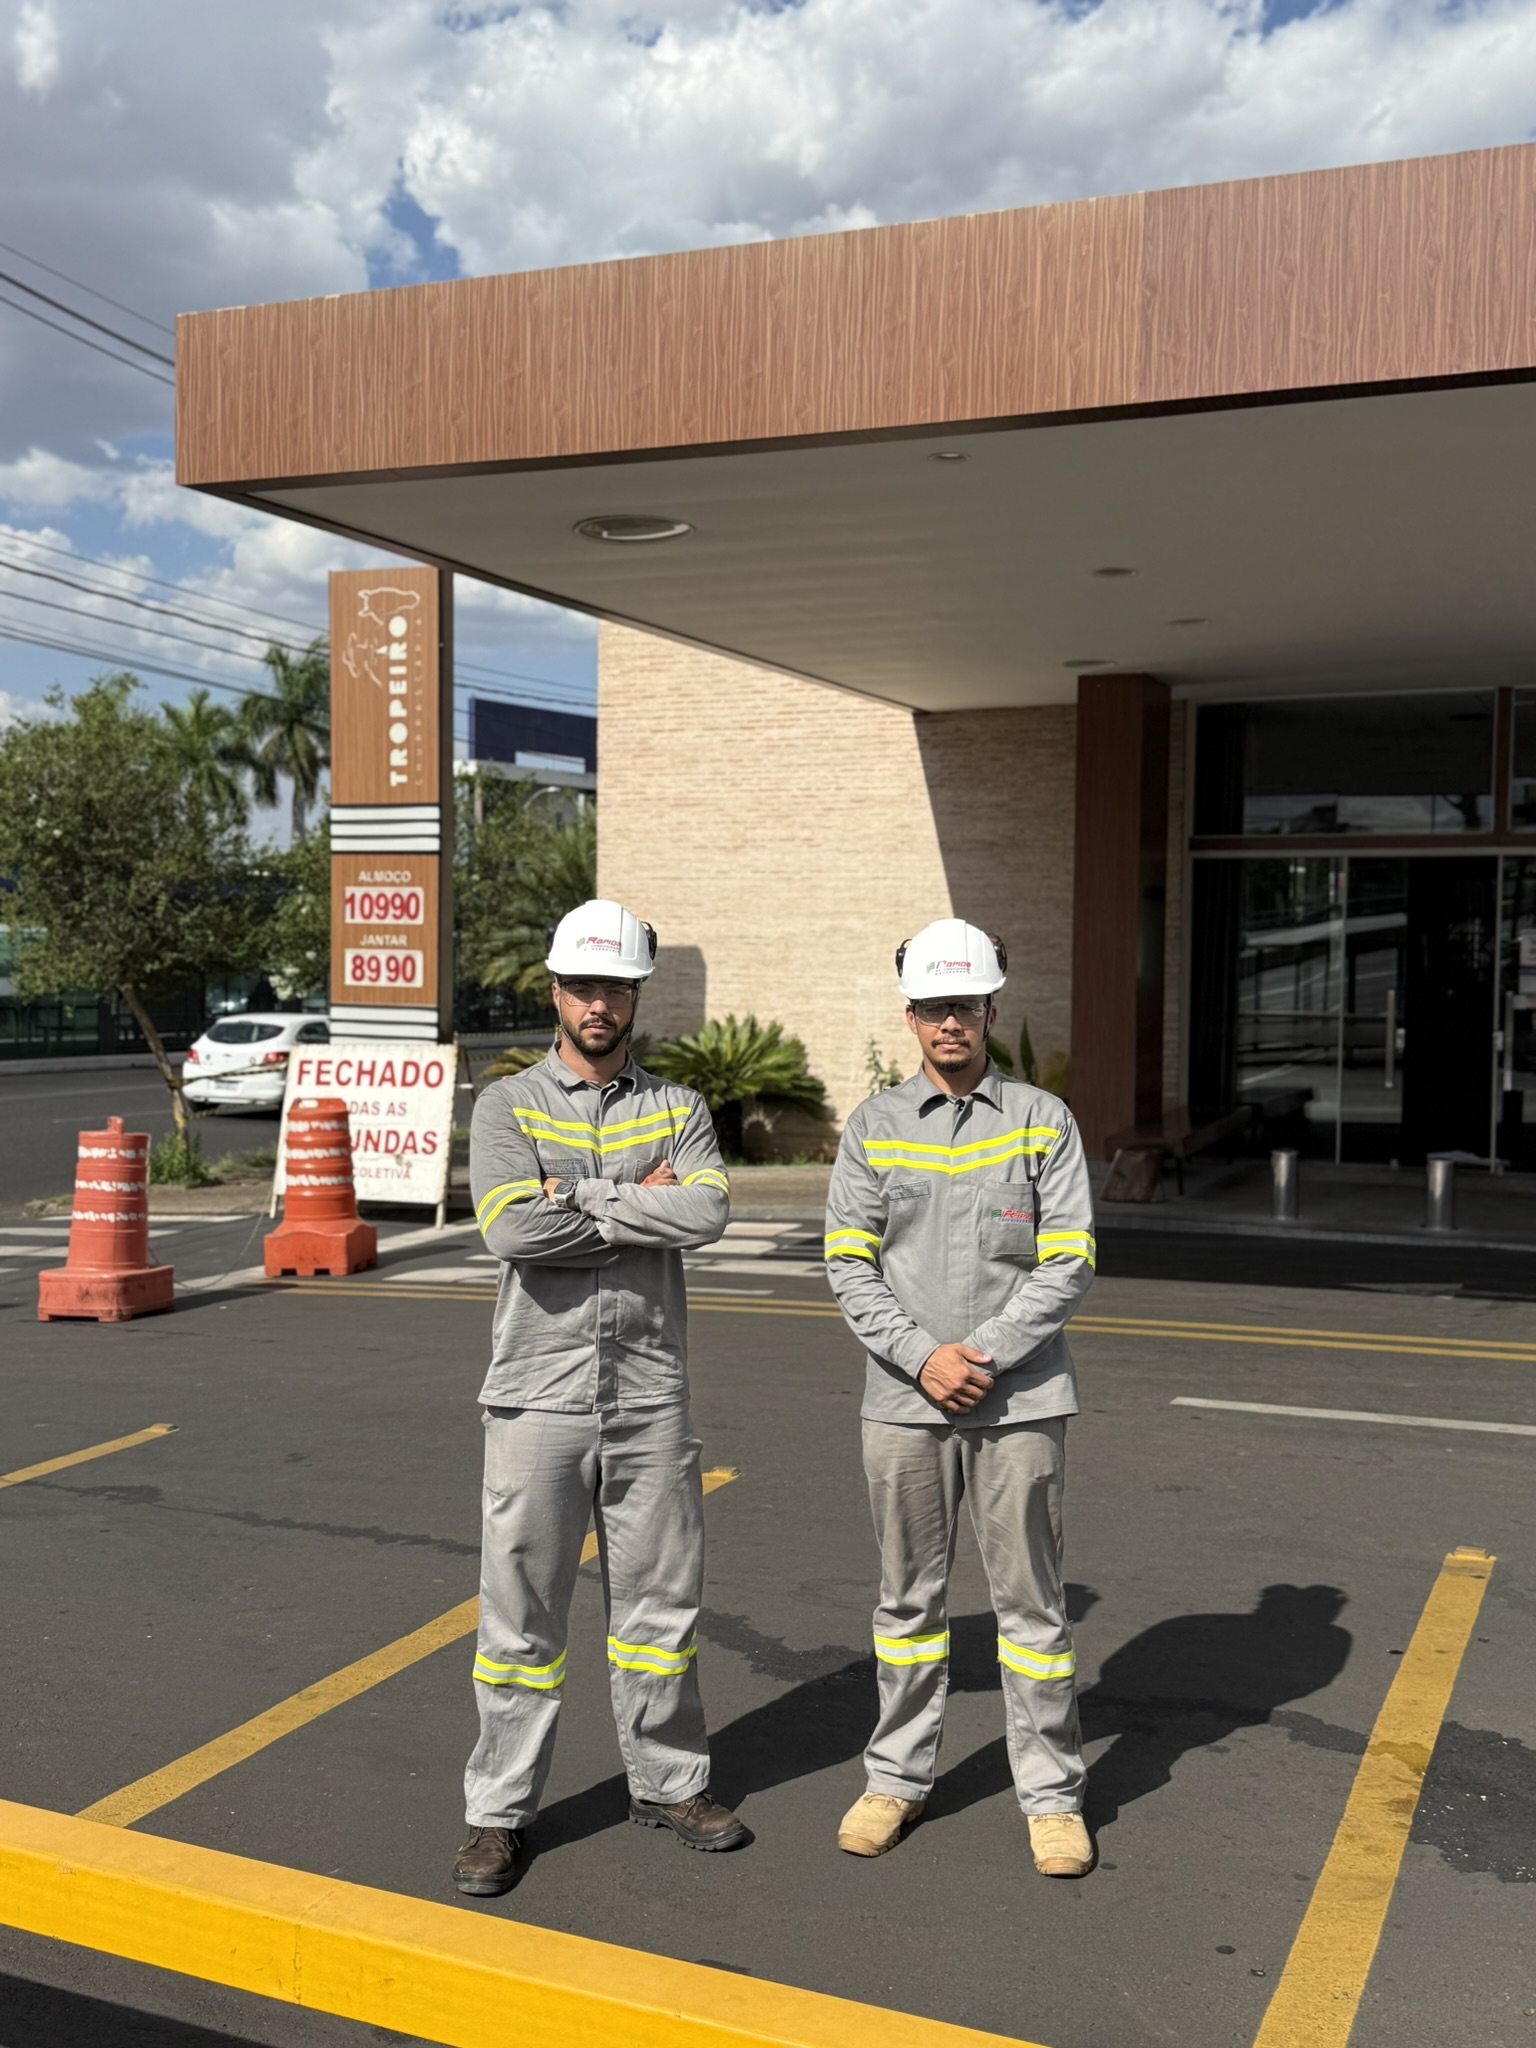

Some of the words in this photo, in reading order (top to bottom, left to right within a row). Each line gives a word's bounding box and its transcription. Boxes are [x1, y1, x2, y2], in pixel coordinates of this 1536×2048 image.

[389, 615, 408, 788] TROPEIRO
[358, 870, 412, 884] ALMOÇO
[344, 892, 420, 921] 10990
[360, 934, 408, 947] JANTAR
[297, 1059, 445, 1089] FECHADO
[349, 1100, 381, 1116] DAS
[386, 1101, 407, 1117] AS
[351, 1129, 438, 1156] UNDAS
[353, 1166, 411, 1180] COLETIVA
